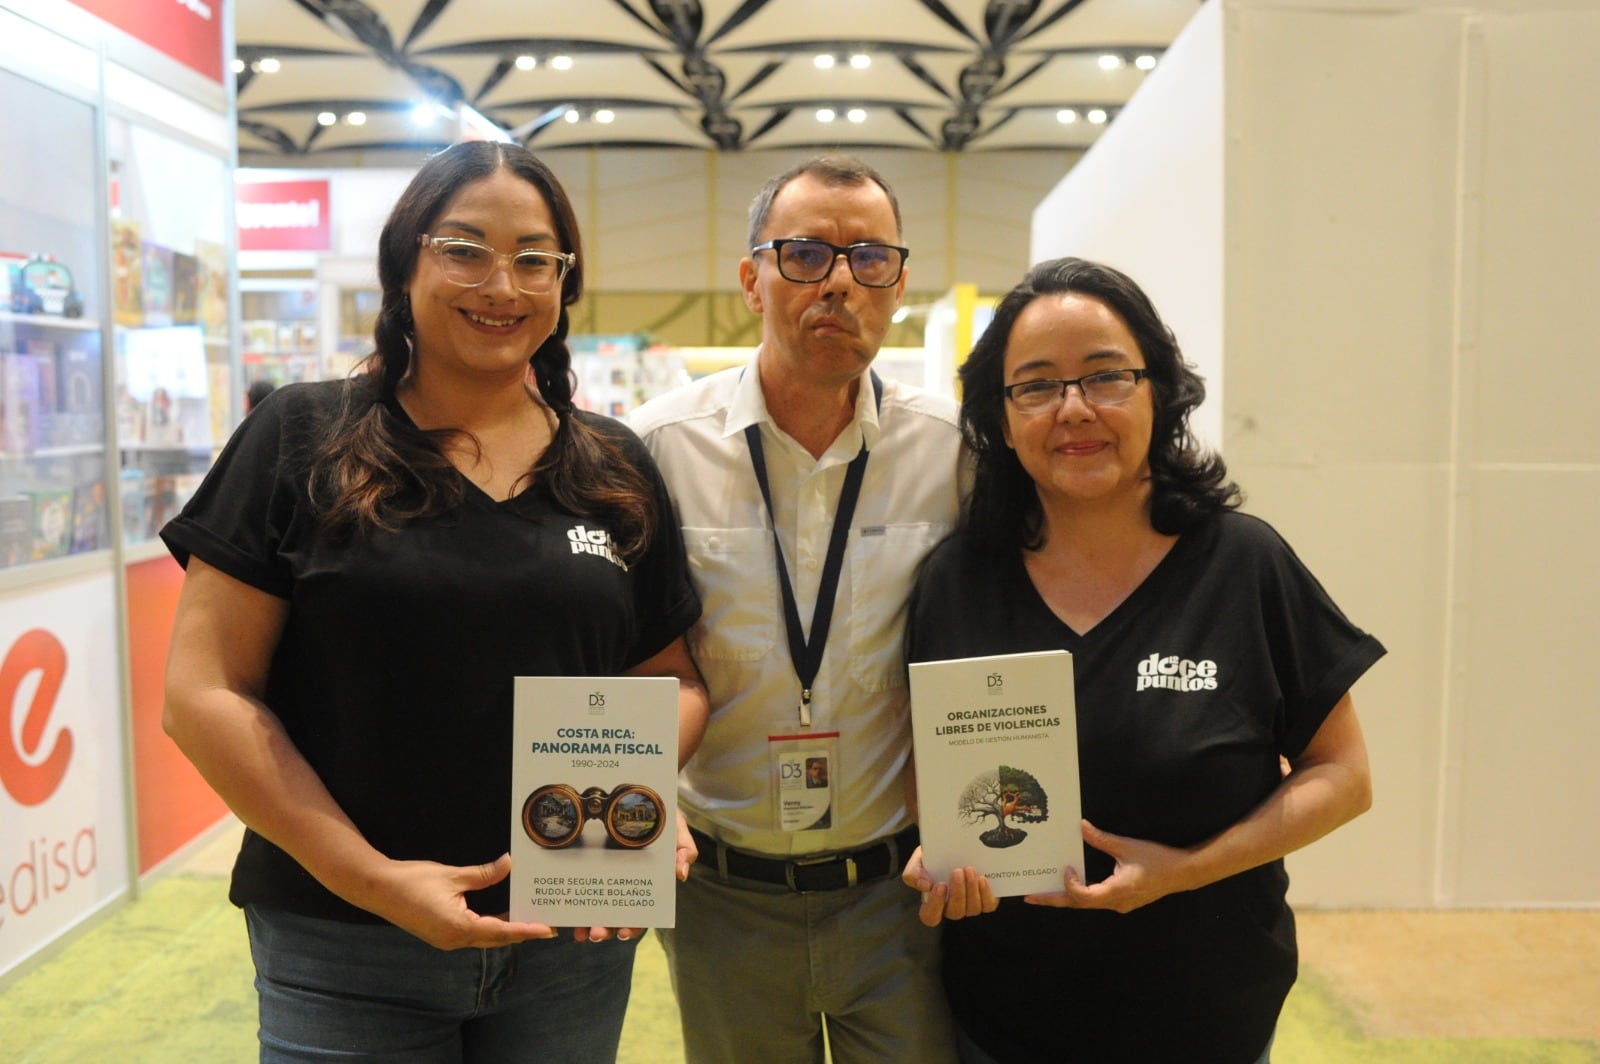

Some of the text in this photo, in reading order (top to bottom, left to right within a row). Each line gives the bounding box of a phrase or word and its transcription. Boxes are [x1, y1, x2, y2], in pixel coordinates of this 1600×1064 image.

[1137, 652, 1218, 678] doce
[1136, 675, 1218, 692] puntos
[947, 705, 1047, 721] ORGANIZACIONES
[936, 717, 1061, 736] LIBRES DE VIOLENCIAS
[557, 728, 635, 739] COSTA RICA:
[949, 738, 974, 746] MODELO
[1013, 733, 1049, 742] HUMANISTA
[532, 742, 663, 755] PANORAMA FISCAL
[571, 760, 620, 768] 1990-2024
[1022, 867, 1058, 877] DELGADO
[534, 877, 653, 886] ROGER SEGURA CARMONA
[535, 888, 572, 896] RUDOLF
[607, 887, 652, 897] BOLAÑOS
[531, 898, 655, 907] VERNY MONTOYA DELGADO
